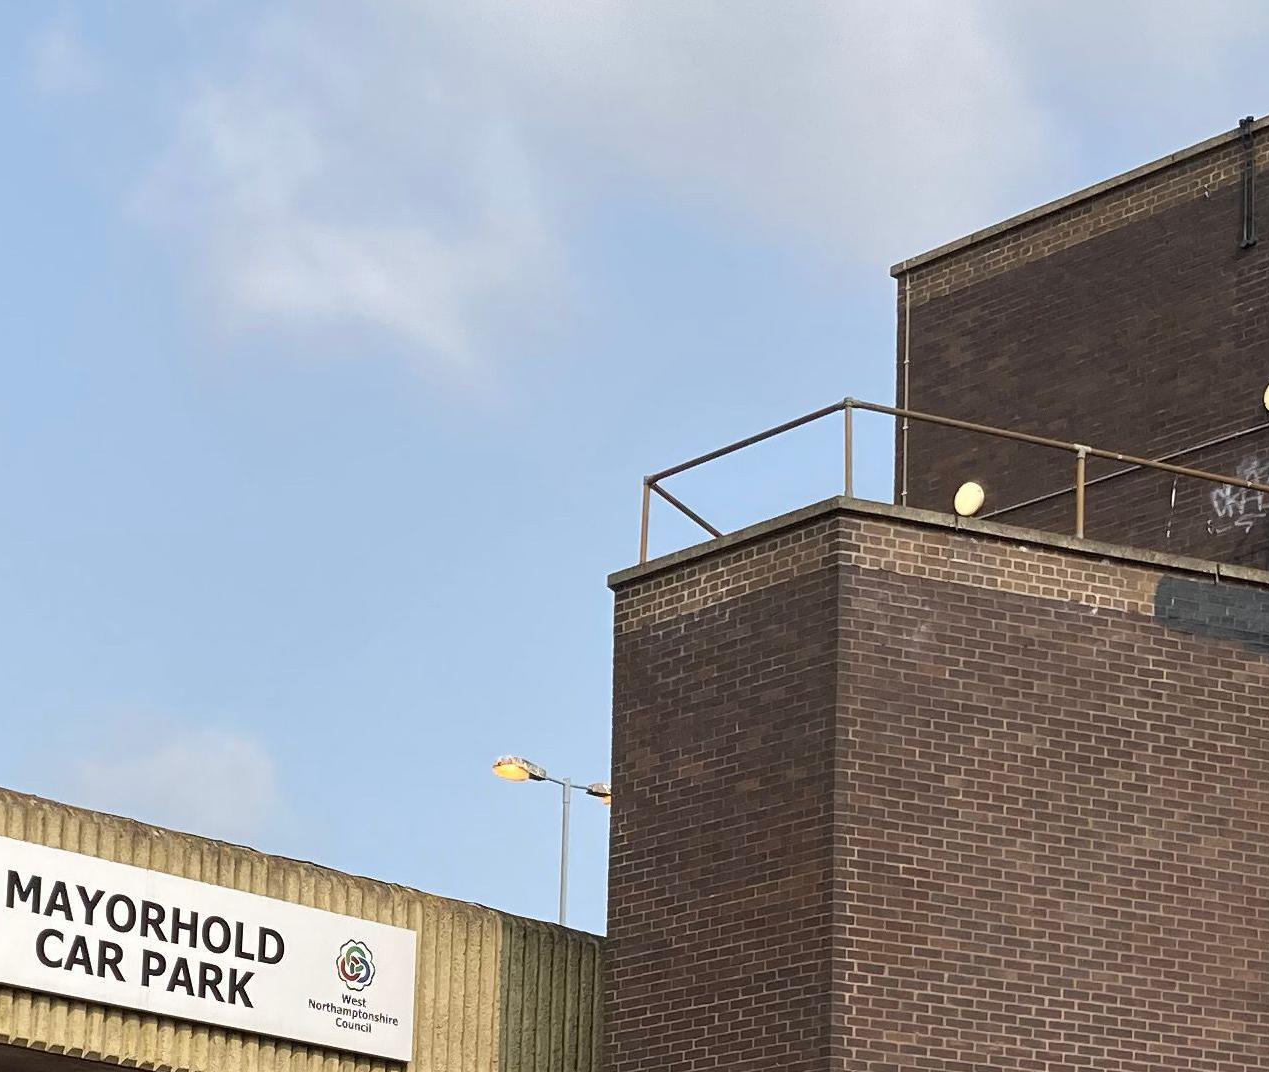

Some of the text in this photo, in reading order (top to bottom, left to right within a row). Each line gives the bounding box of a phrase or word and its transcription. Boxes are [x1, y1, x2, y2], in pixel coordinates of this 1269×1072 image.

[5, 869, 286, 965] MAYORHOLD
[35, 928, 255, 1009] CAR PARK
[308, 998, 399, 1027] Northamptonshire
[341, 992, 367, 1009] West
[335, 1017, 372, 1034] Council
